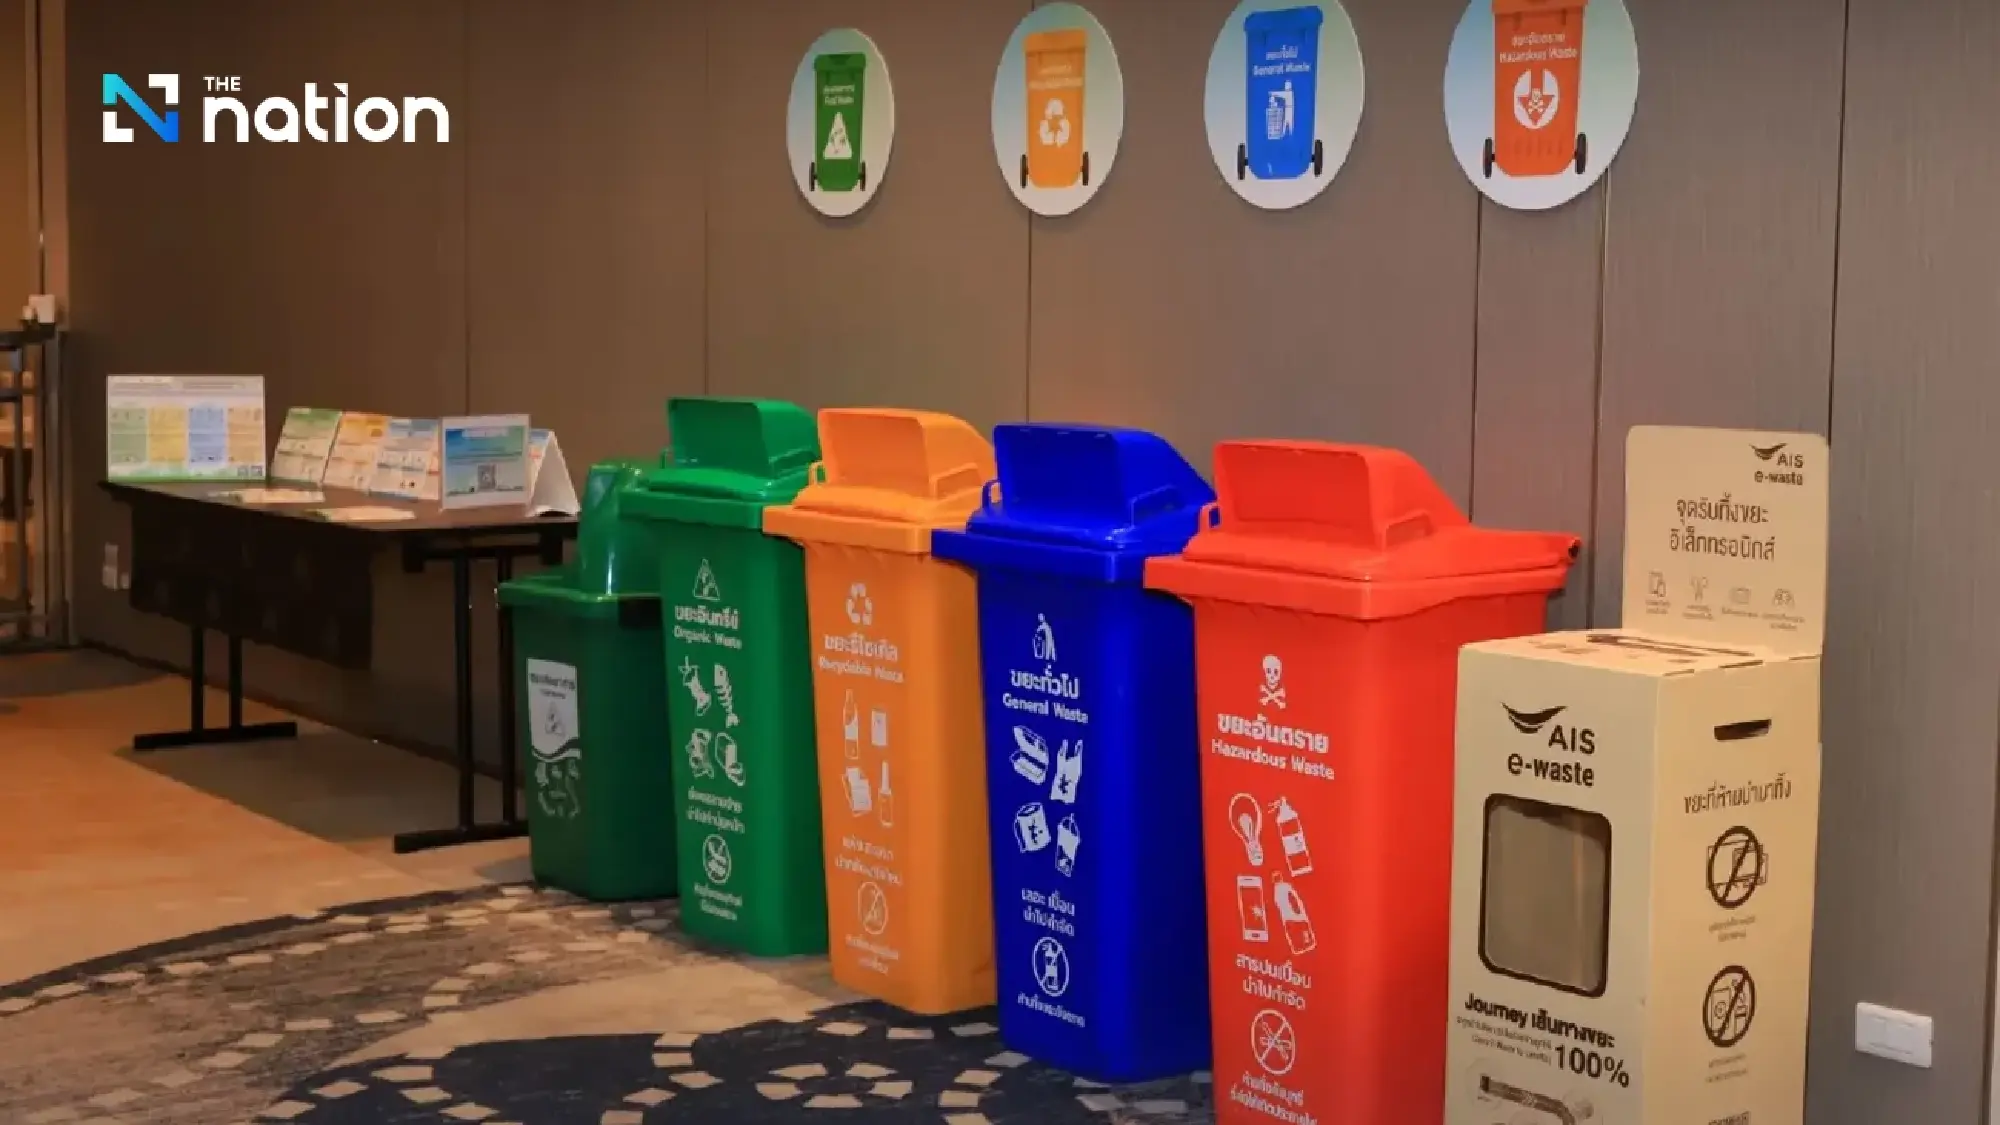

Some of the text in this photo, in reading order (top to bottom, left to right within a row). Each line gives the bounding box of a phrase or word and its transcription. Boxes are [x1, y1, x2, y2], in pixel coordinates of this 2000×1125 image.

[1254, 63, 1283, 76] General
[1754, 470, 1803, 485] e-waste
[1777, 453, 1803, 468] AIS
[1677, 490, 1769, 526] จุดรับทิ้งขยะ
[1670, 525, 1775, 561] อิเล็กทรอนิกส์
[674, 625, 742, 649] Organic Waste
[1010, 664, 1080, 699] ขยะทั่วไป
[1003, 693, 1088, 723] General Waste
[1218, 713, 1329, 753] ขยะอันตราย
[1548, 725, 1595, 755] AIS
[1211, 739, 1334, 780] Hazardous Waste
[1508, 753, 1594, 787] e-waste
[1684, 772, 1792, 814] ขยะที่ห้ามนำมาทิ้ง
[1236, 953, 1312, 989] สารปนเปื้อน
[1465, 992, 1528, 1029] Journey
[1532, 1008, 1615, 1048] เส้นทางขยะ
[1555, 1043, 1629, 1088] 100%
